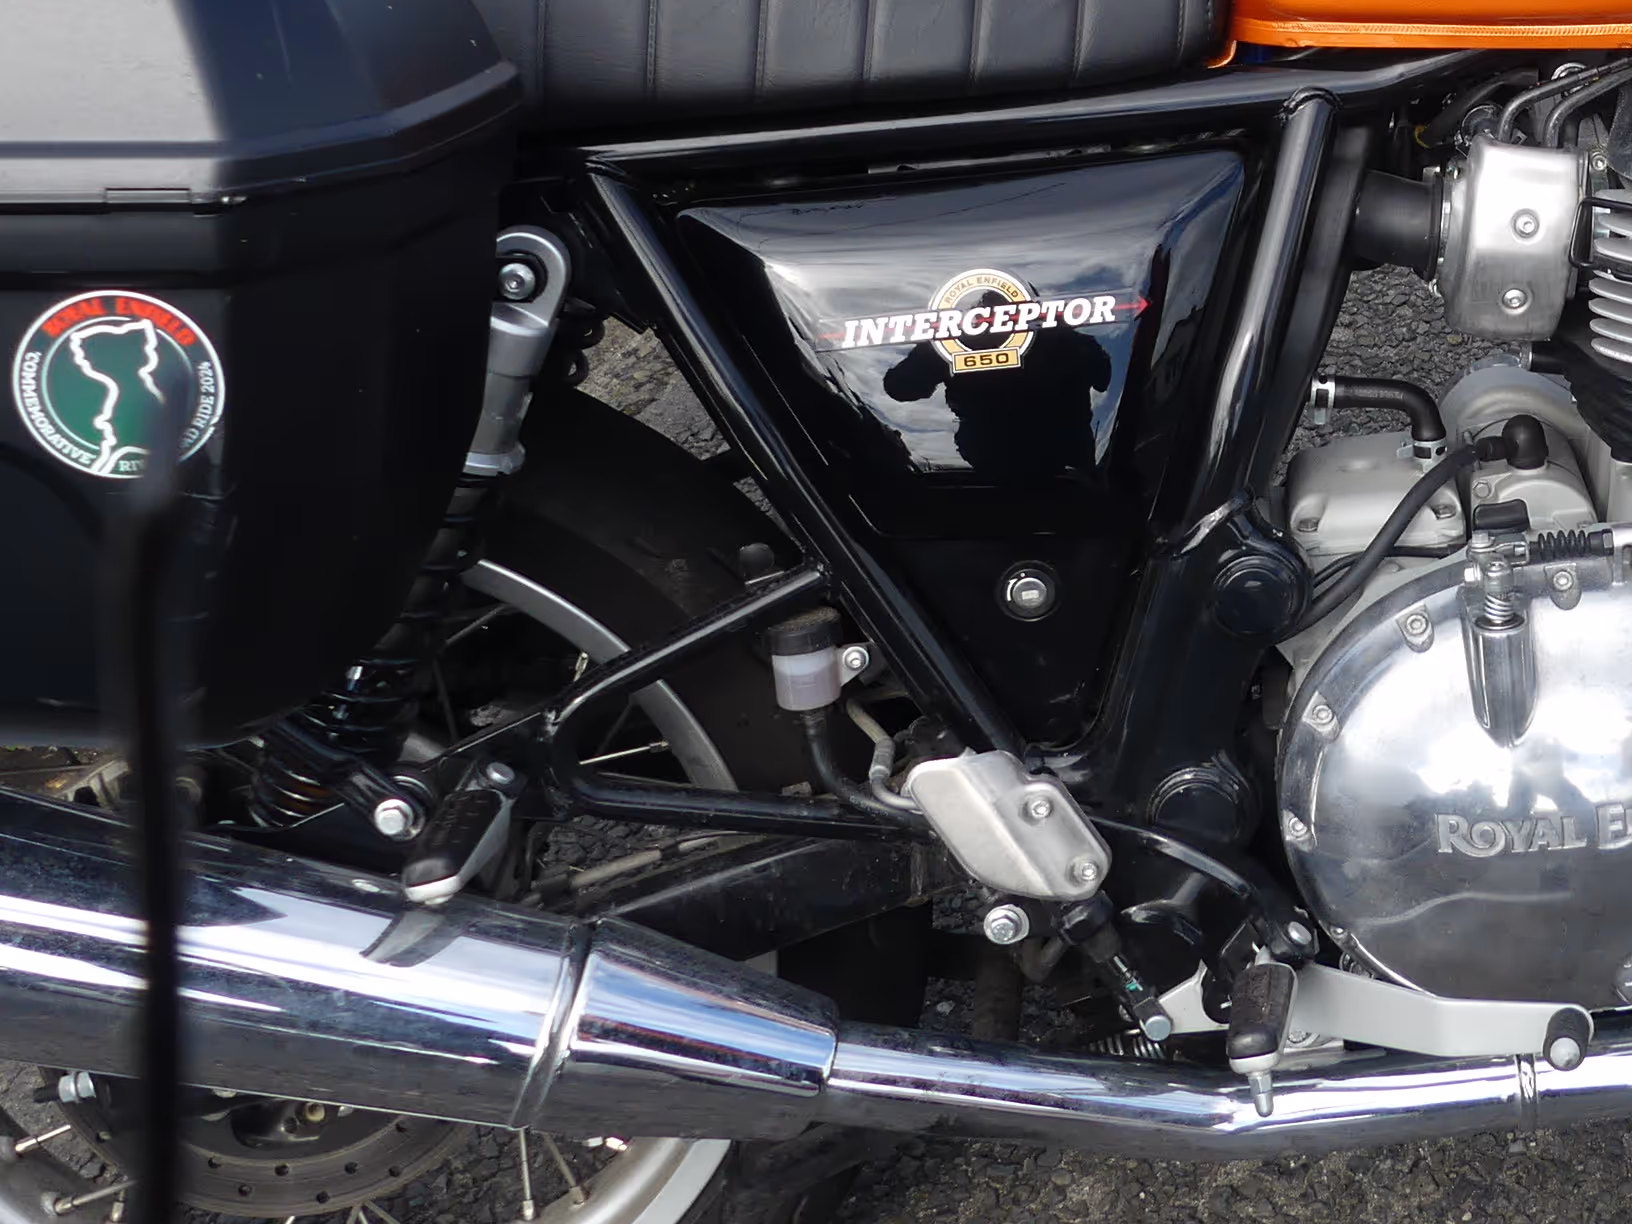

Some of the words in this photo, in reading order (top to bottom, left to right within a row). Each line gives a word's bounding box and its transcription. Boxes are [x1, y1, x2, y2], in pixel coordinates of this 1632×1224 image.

[944, 279, 974, 304] ROYAL
[976, 276, 1019, 298] ENFIELD
[841, 295, 1116, 349] INTERCEPTOR
[963, 352, 1009, 368] 650
[198, 361, 215, 393] 2024
[1435, 812, 1588, 858] ROYAL
